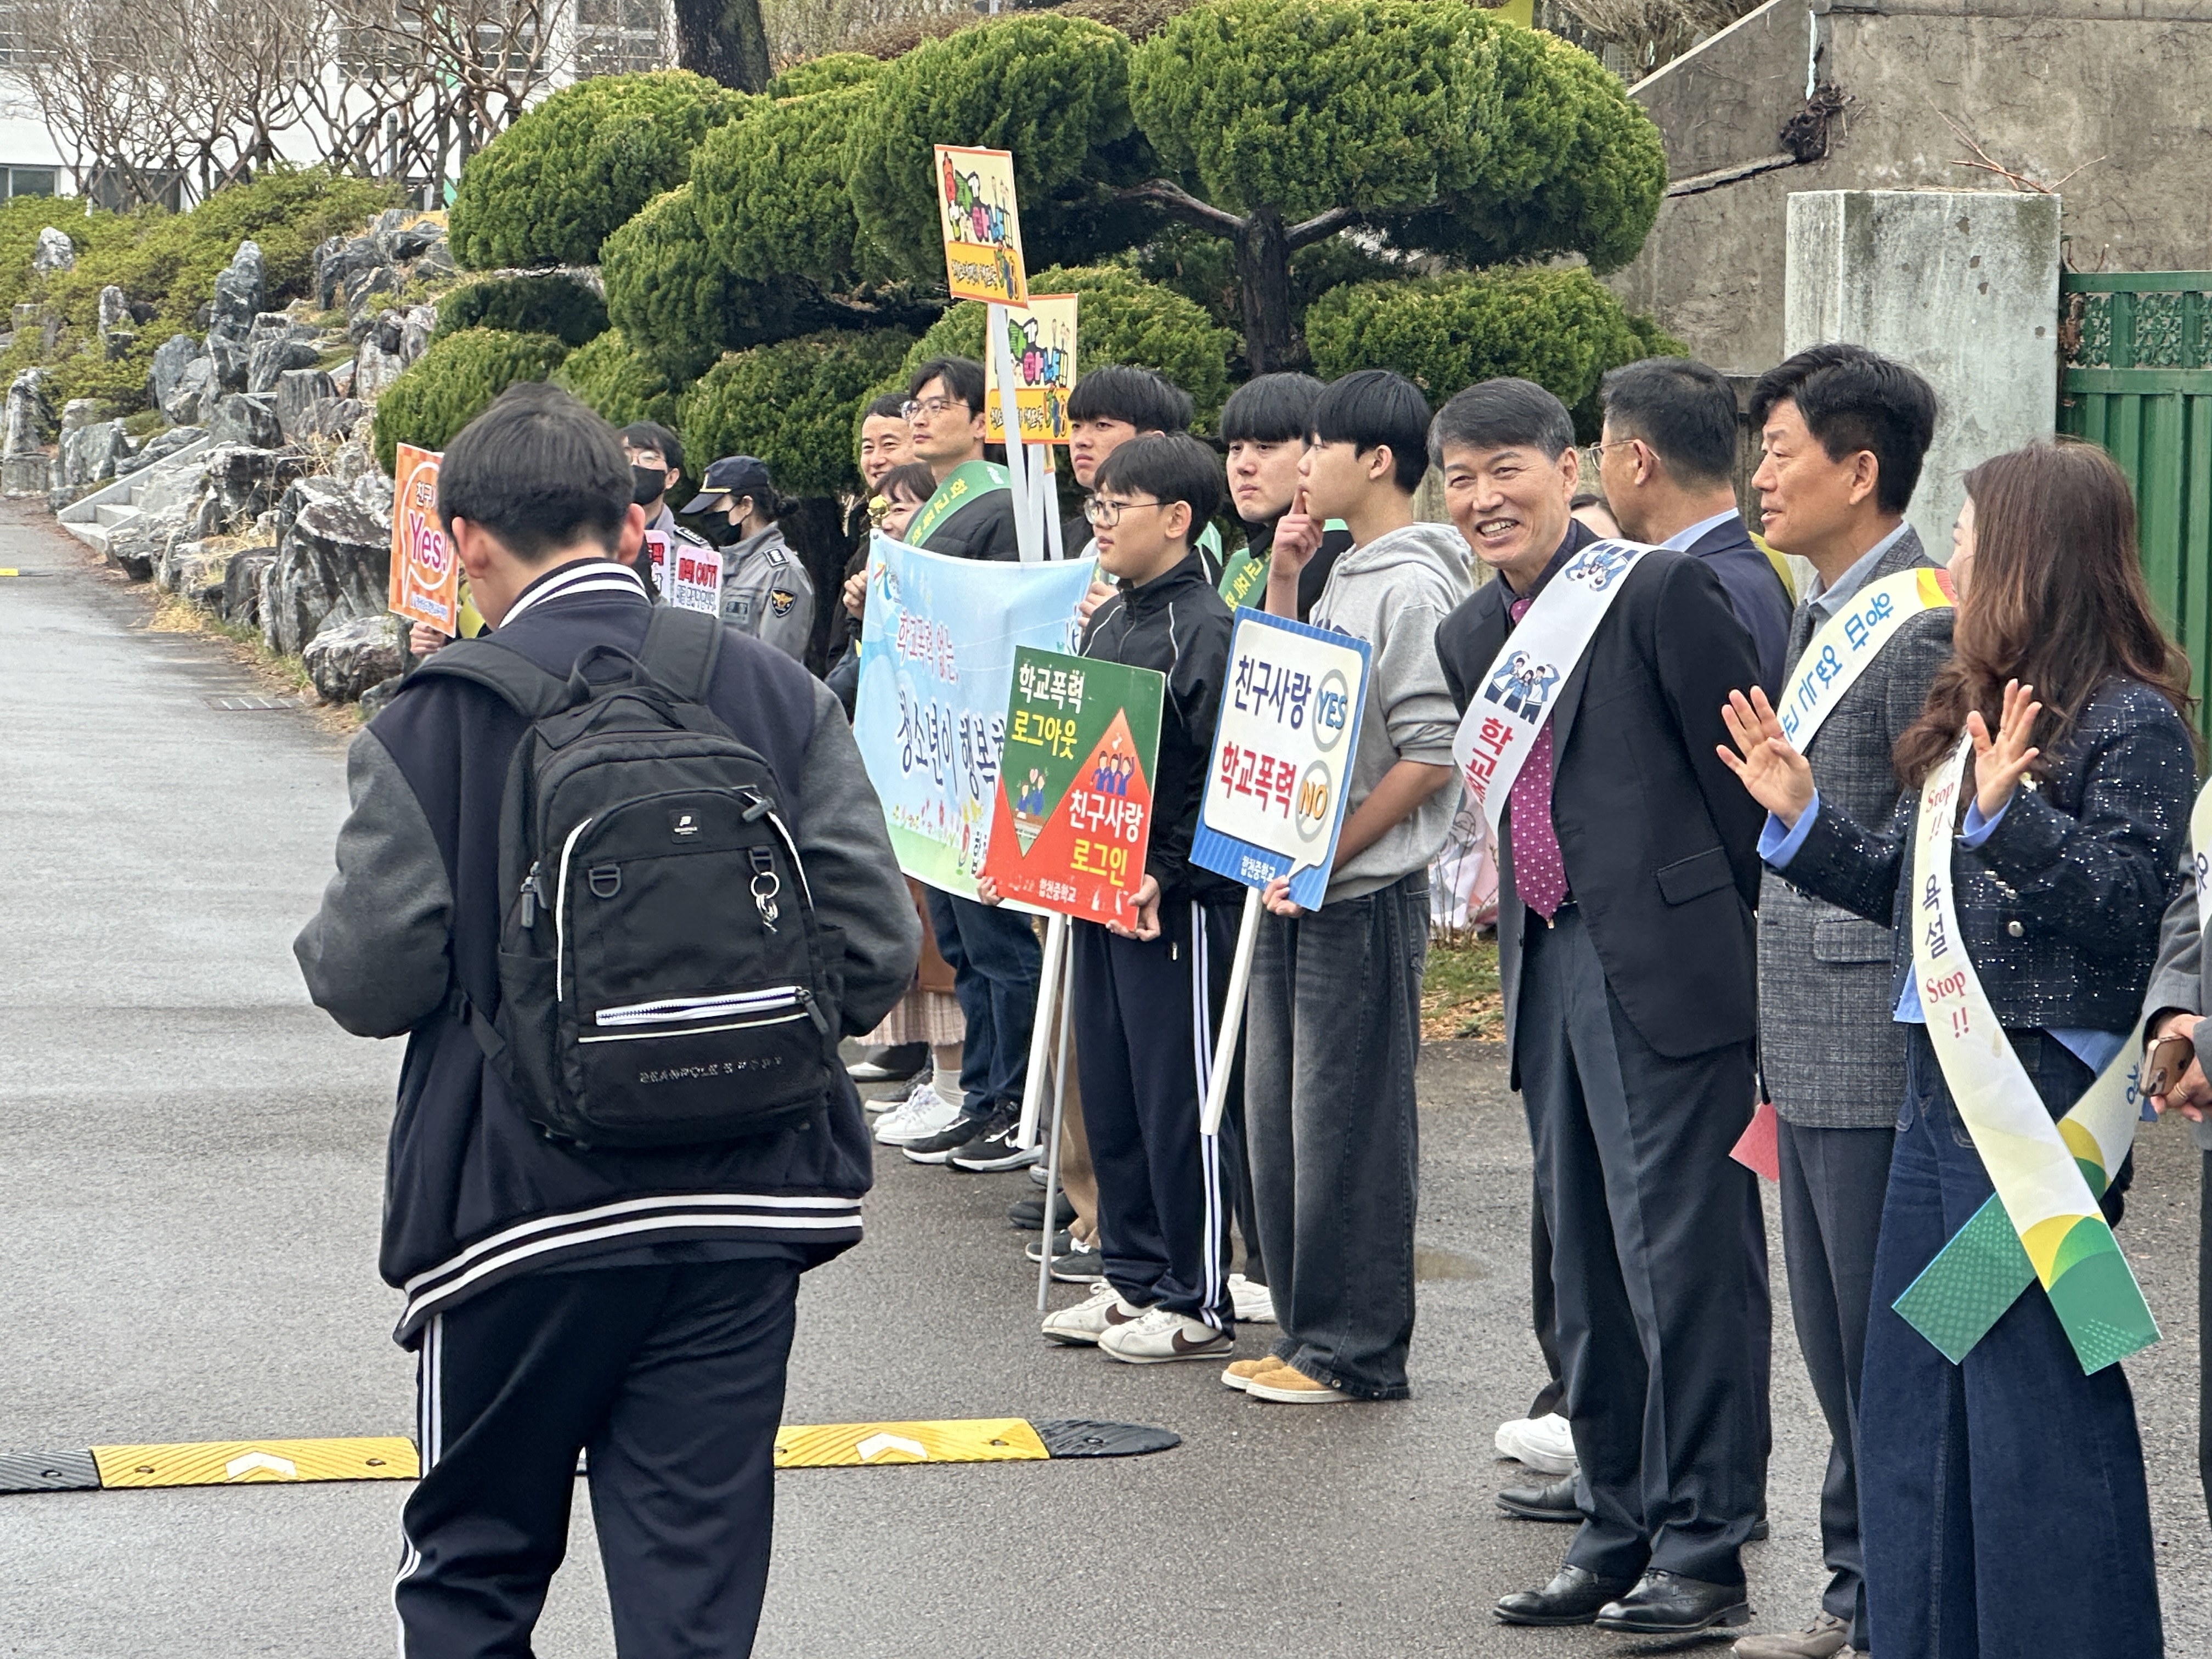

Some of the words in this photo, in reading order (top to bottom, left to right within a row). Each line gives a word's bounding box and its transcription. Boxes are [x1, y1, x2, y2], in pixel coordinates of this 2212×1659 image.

[1019, 663, 1085, 714] 학교폭력
[1235, 654, 1311, 729] 친구사랑
[1317, 688, 1347, 729] YES
[897, 690, 957, 797] 청소년이
[1011, 710, 1077, 760] 로그아웃
[1221, 741, 1296, 819] 학교폭력
[1299, 779, 1328, 820] NO
[1926, 781, 1954, 813] Stop
[1069, 789, 1144, 843] 친구사랑
[1070, 838, 1128, 887] 로그인
[1039, 878, 1077, 904] 합천중학교
[1922, 874, 1948, 959] 욕설
[1926, 970, 1966, 1005] Stop
